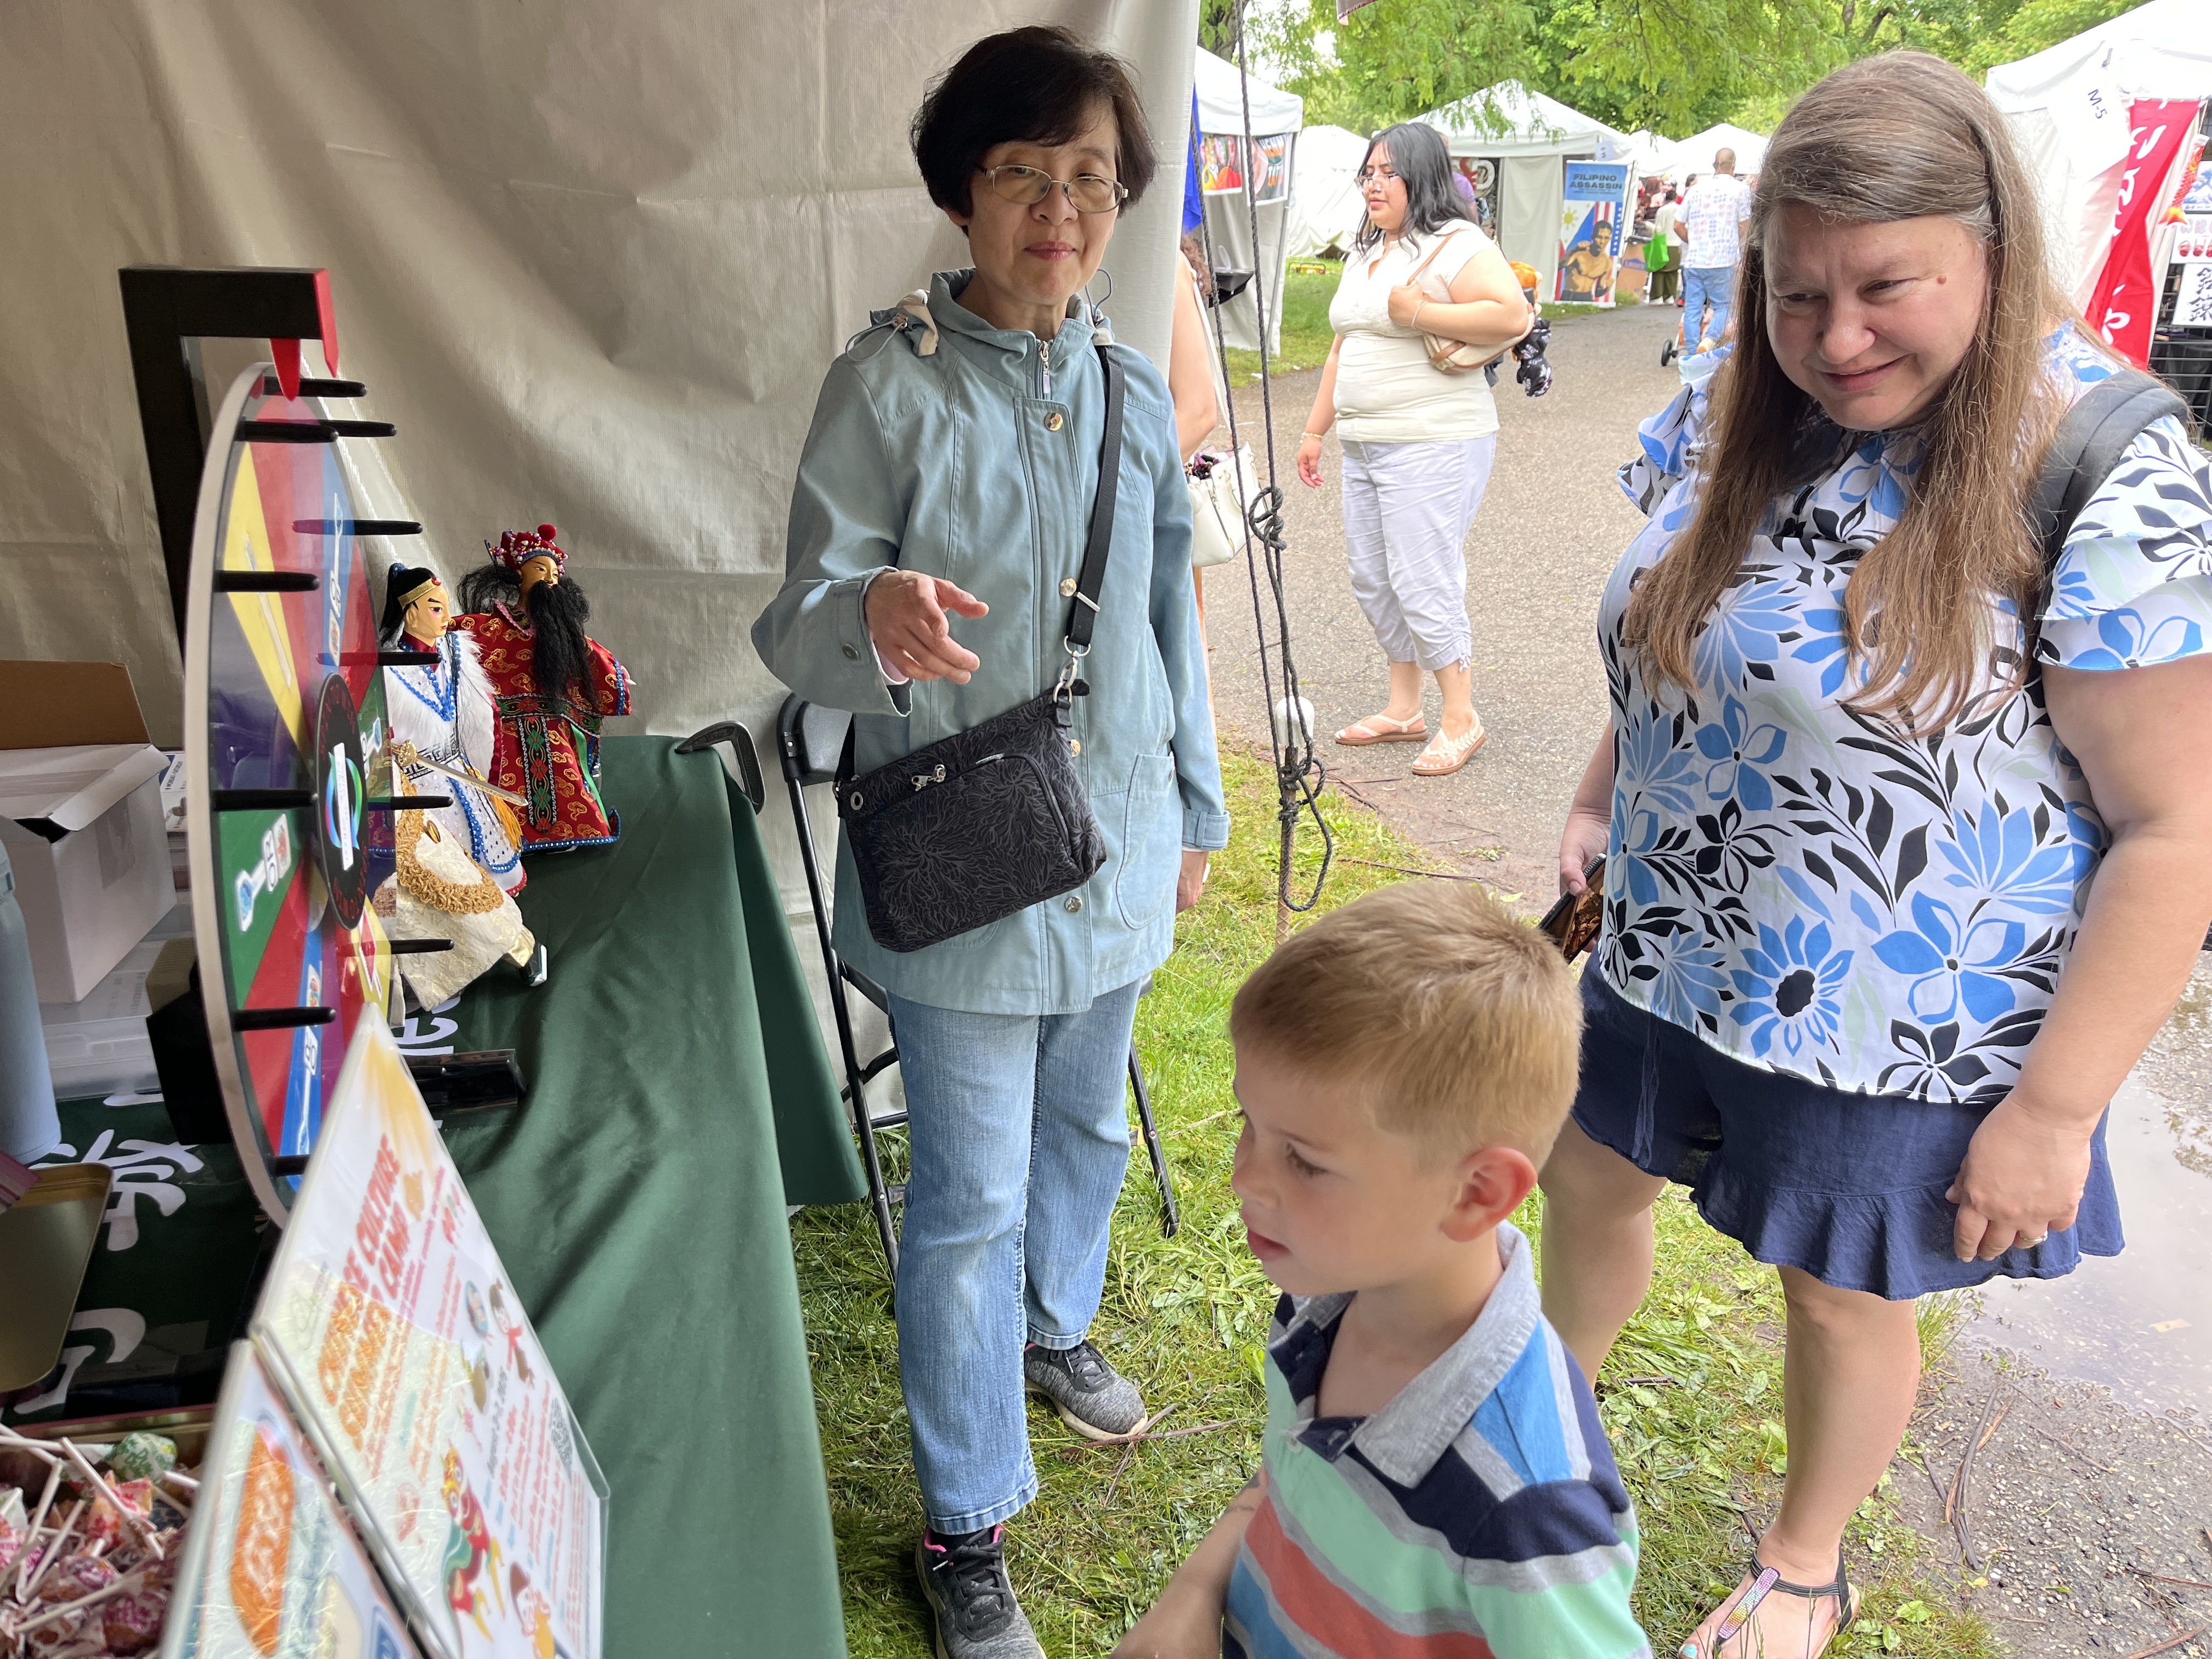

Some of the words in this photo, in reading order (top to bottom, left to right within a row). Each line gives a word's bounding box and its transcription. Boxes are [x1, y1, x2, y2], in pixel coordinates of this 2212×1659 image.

[2087, 88, 2108, 119] M-5
[1570, 181, 1623, 189] ASSASSIN
[1573, 173, 1617, 182] FILIPINO
[318, 1248, 369, 1406] CHINESE
[357, 1133, 399, 1266] CULTURE
[377, 1201, 410, 1301] CAMP
[488, 1427, 499, 1480] August
[497, 1364, 506, 1404] 2026
